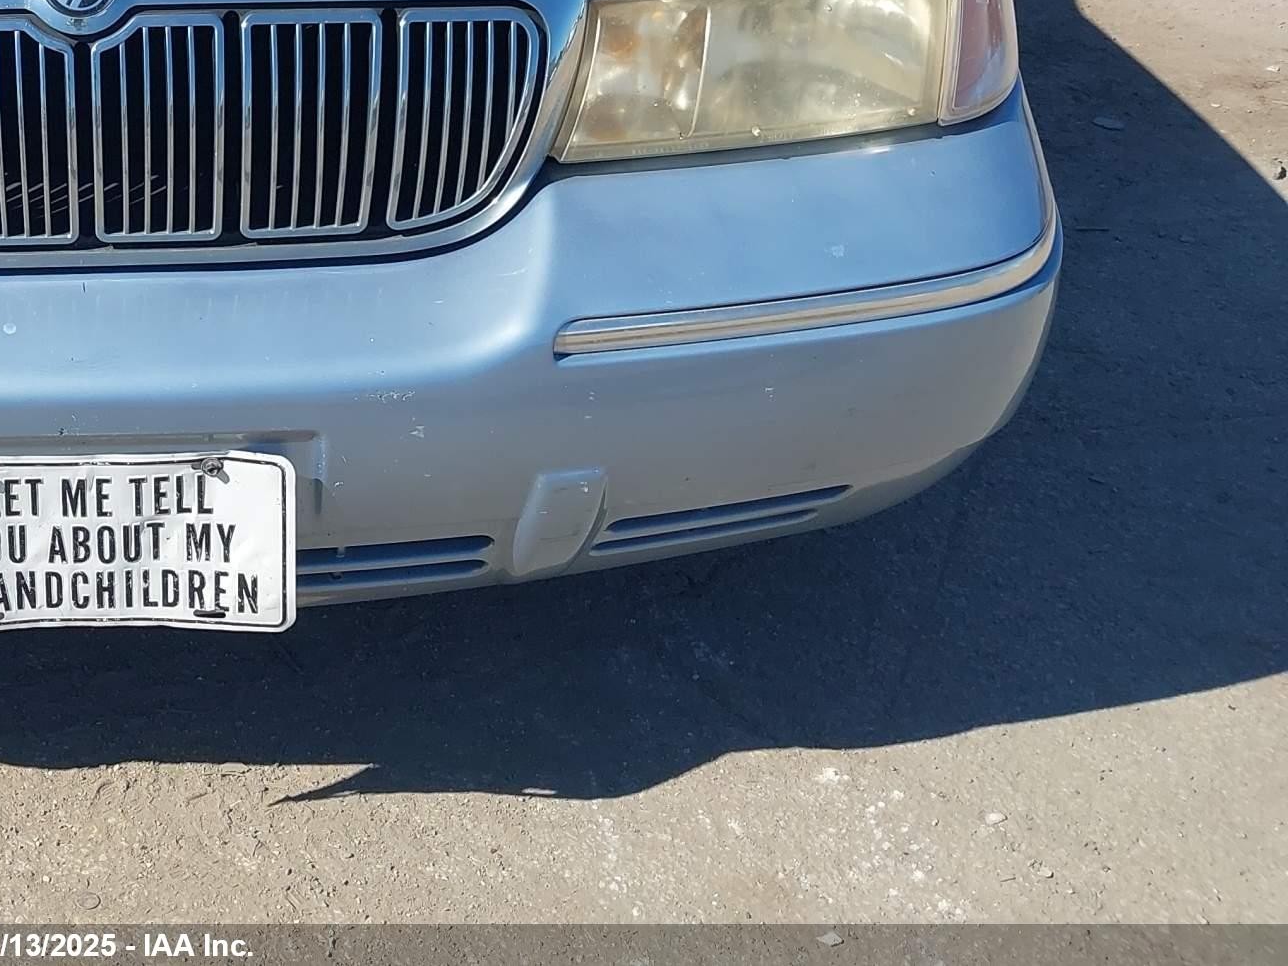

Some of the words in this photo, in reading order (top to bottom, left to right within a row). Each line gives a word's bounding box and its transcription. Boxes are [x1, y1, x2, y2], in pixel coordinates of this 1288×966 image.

[62, 477, 113, 518] ME
[128, 474, 214, 516] TELL
[48, 522, 165, 564] ABOUT
[186, 523, 236, 563] MY
